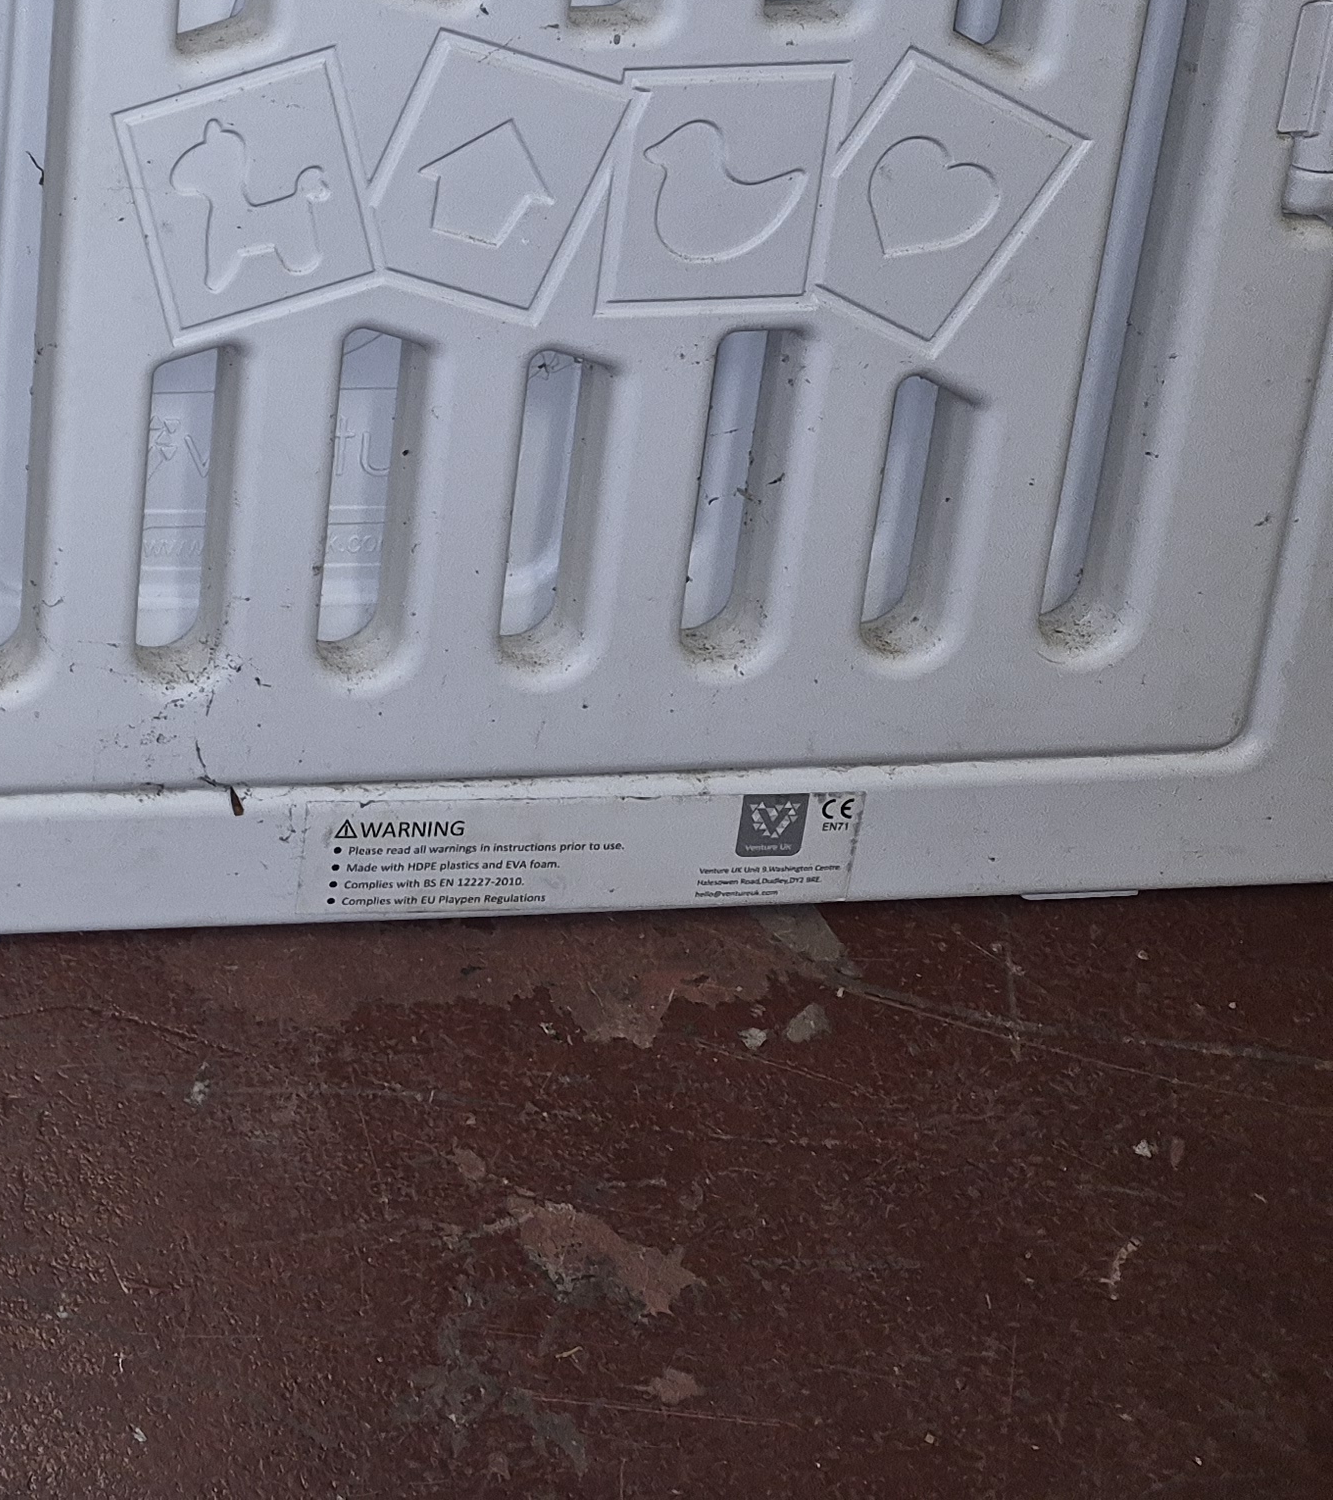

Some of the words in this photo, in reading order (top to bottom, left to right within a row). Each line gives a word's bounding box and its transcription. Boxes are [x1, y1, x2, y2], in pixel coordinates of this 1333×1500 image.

[360, 820, 466, 839] WARNING
[822, 822, 849, 831] EN71
[348, 846, 383, 856] Please
[386, 845, 411, 855] read
[413, 844, 427, 854] all
[429, 843, 477, 854] warnings
[480, 843, 491, 852] in
[493, 842, 557, 852] instructions
[559, 841, 587, 853] prior
[589, 842, 601, 851] to
[603, 842, 625, 851] use.
[745, 843, 778, 852] Venture
[346, 862, 378, 872] Made
[381, 862, 405, 872] with
[407, 861, 438, 871] HDPE
[439, 860, 479, 872] plastics
[482, 860, 503, 870] and
[505, 860, 527, 869] EVA
[529, 859, 561, 869] foam.
[699, 867, 729, 875] Venture
[730, 866, 743, 874] UK
[744, 866, 760, 874] Unit
[815, 864, 841, 872] Centre
[344, 879, 394, 890] Complies
[396, 878, 420, 888] with
[423, 878, 437, 888] BS
[439, 878, 454, 887] EN
[457, 876, 525, 887] 12227-2010.
[341, 896, 392, 907] Complies
[394, 895, 418, 905] with
[420, 895, 435, 904] EU
[438, 894, 481, 906] Playpen
[483, 893, 546, 905] Regulations
